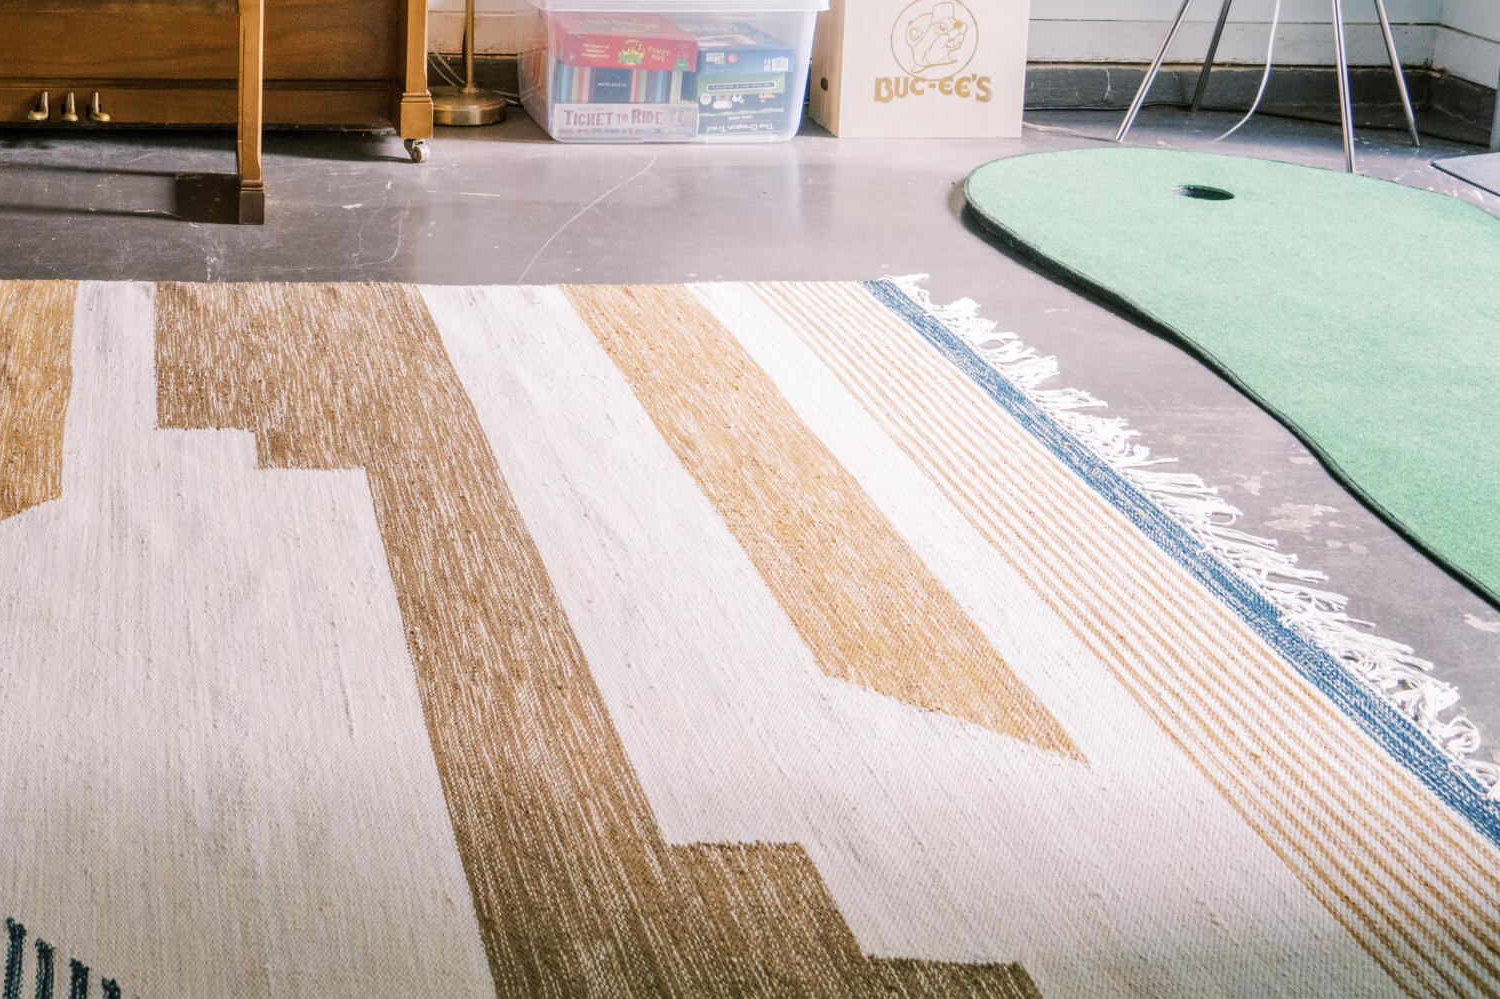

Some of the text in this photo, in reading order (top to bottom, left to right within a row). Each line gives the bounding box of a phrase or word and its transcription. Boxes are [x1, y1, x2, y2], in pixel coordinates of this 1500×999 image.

[874, 73, 993, 104] BUC-EE'S
[564, 108, 664, 126] TICKET TO RIDE
